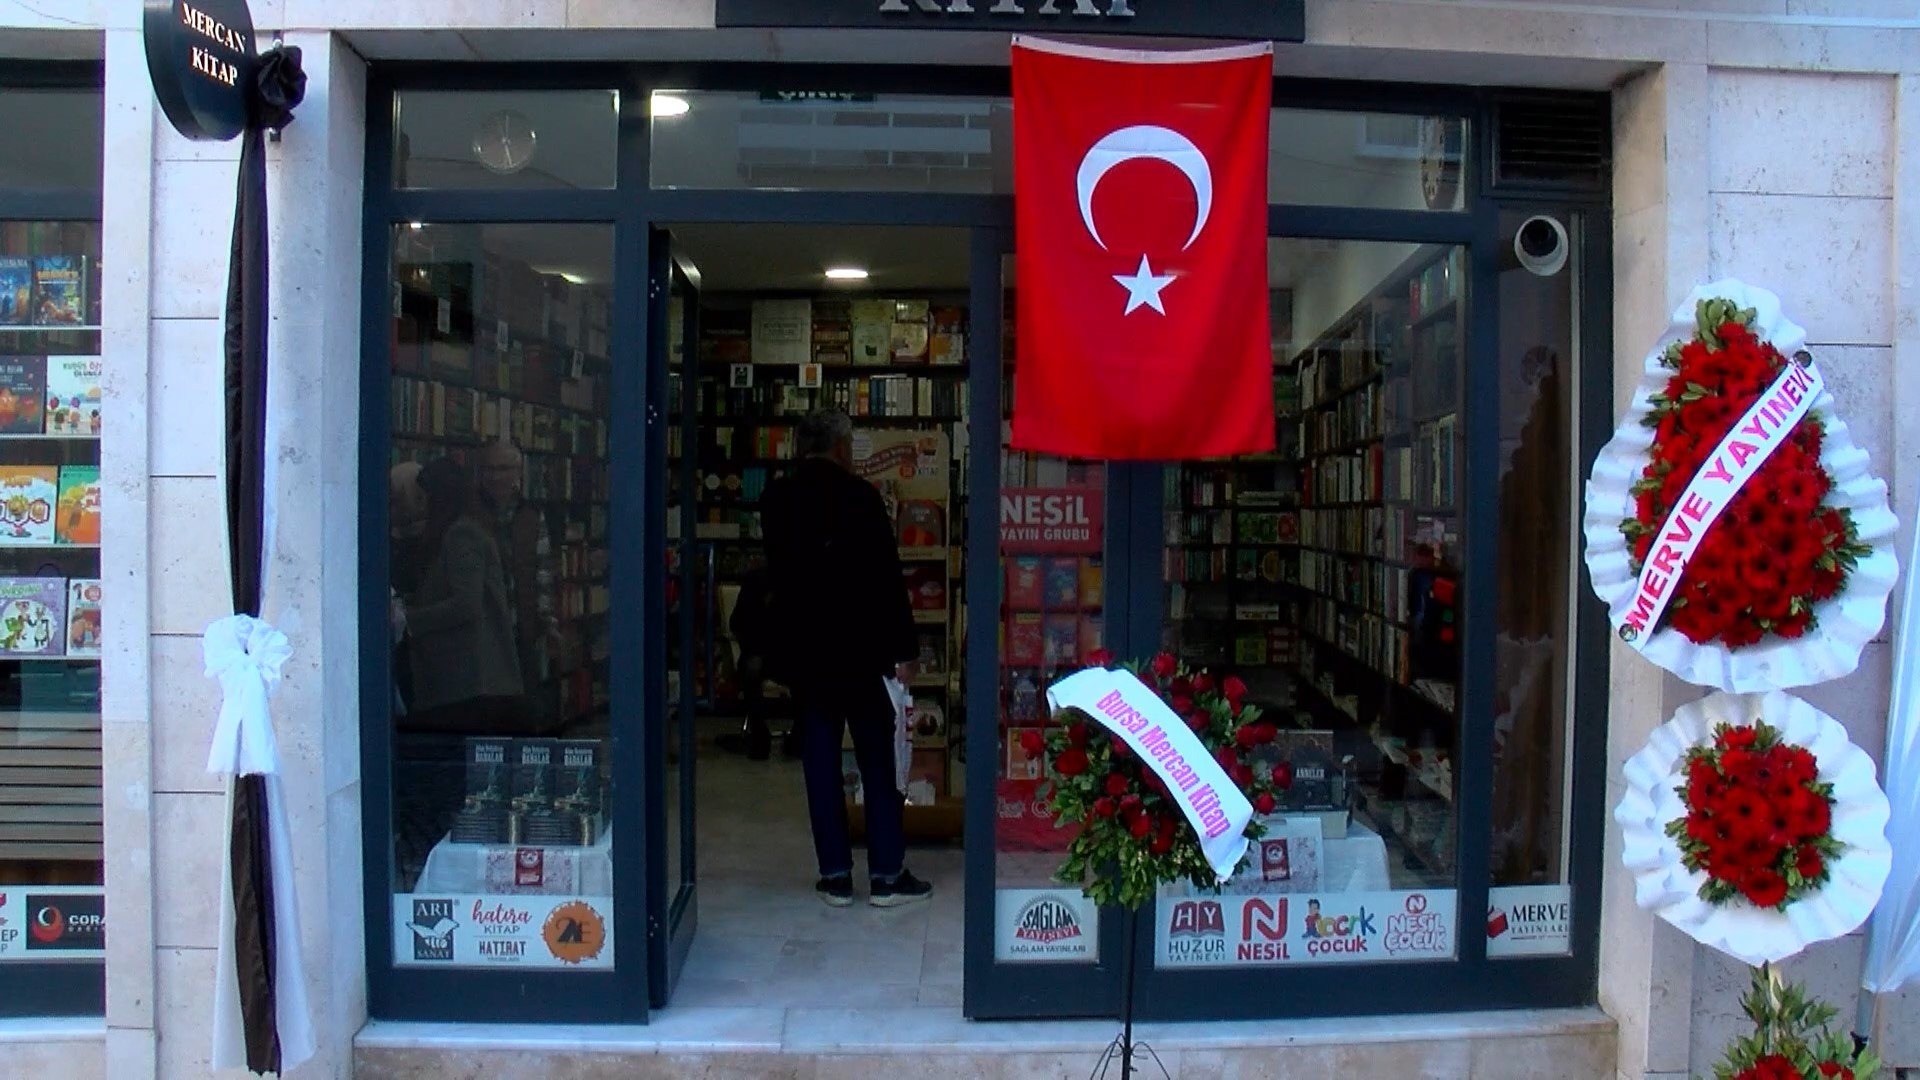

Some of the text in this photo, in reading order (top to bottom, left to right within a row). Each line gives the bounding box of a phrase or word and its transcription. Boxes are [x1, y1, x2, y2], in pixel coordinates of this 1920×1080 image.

[183, 3, 246, 53] MERCAN
[192, 46, 238, 86] KİTAP
[1000, 527, 1089, 541] YAYIN GRUBU
[1626, 491, 1712, 632] MERVE
[1096, 689, 1232, 838] Bursa Mercan Kitap
[416, 903, 448, 917] ARI
[1022, 902, 1074, 931] SAĞLAM
[1511, 903, 1567, 922] MERVE
[484, 924, 520, 934] KİTAP
[1511, 924, 1568, 934] YAYINLARI
[479, 941, 526, 955] HATIRAT
[1169, 939, 1225, 954] HUZUR
[1384, 931, 1446, 955] ÇOCUK
